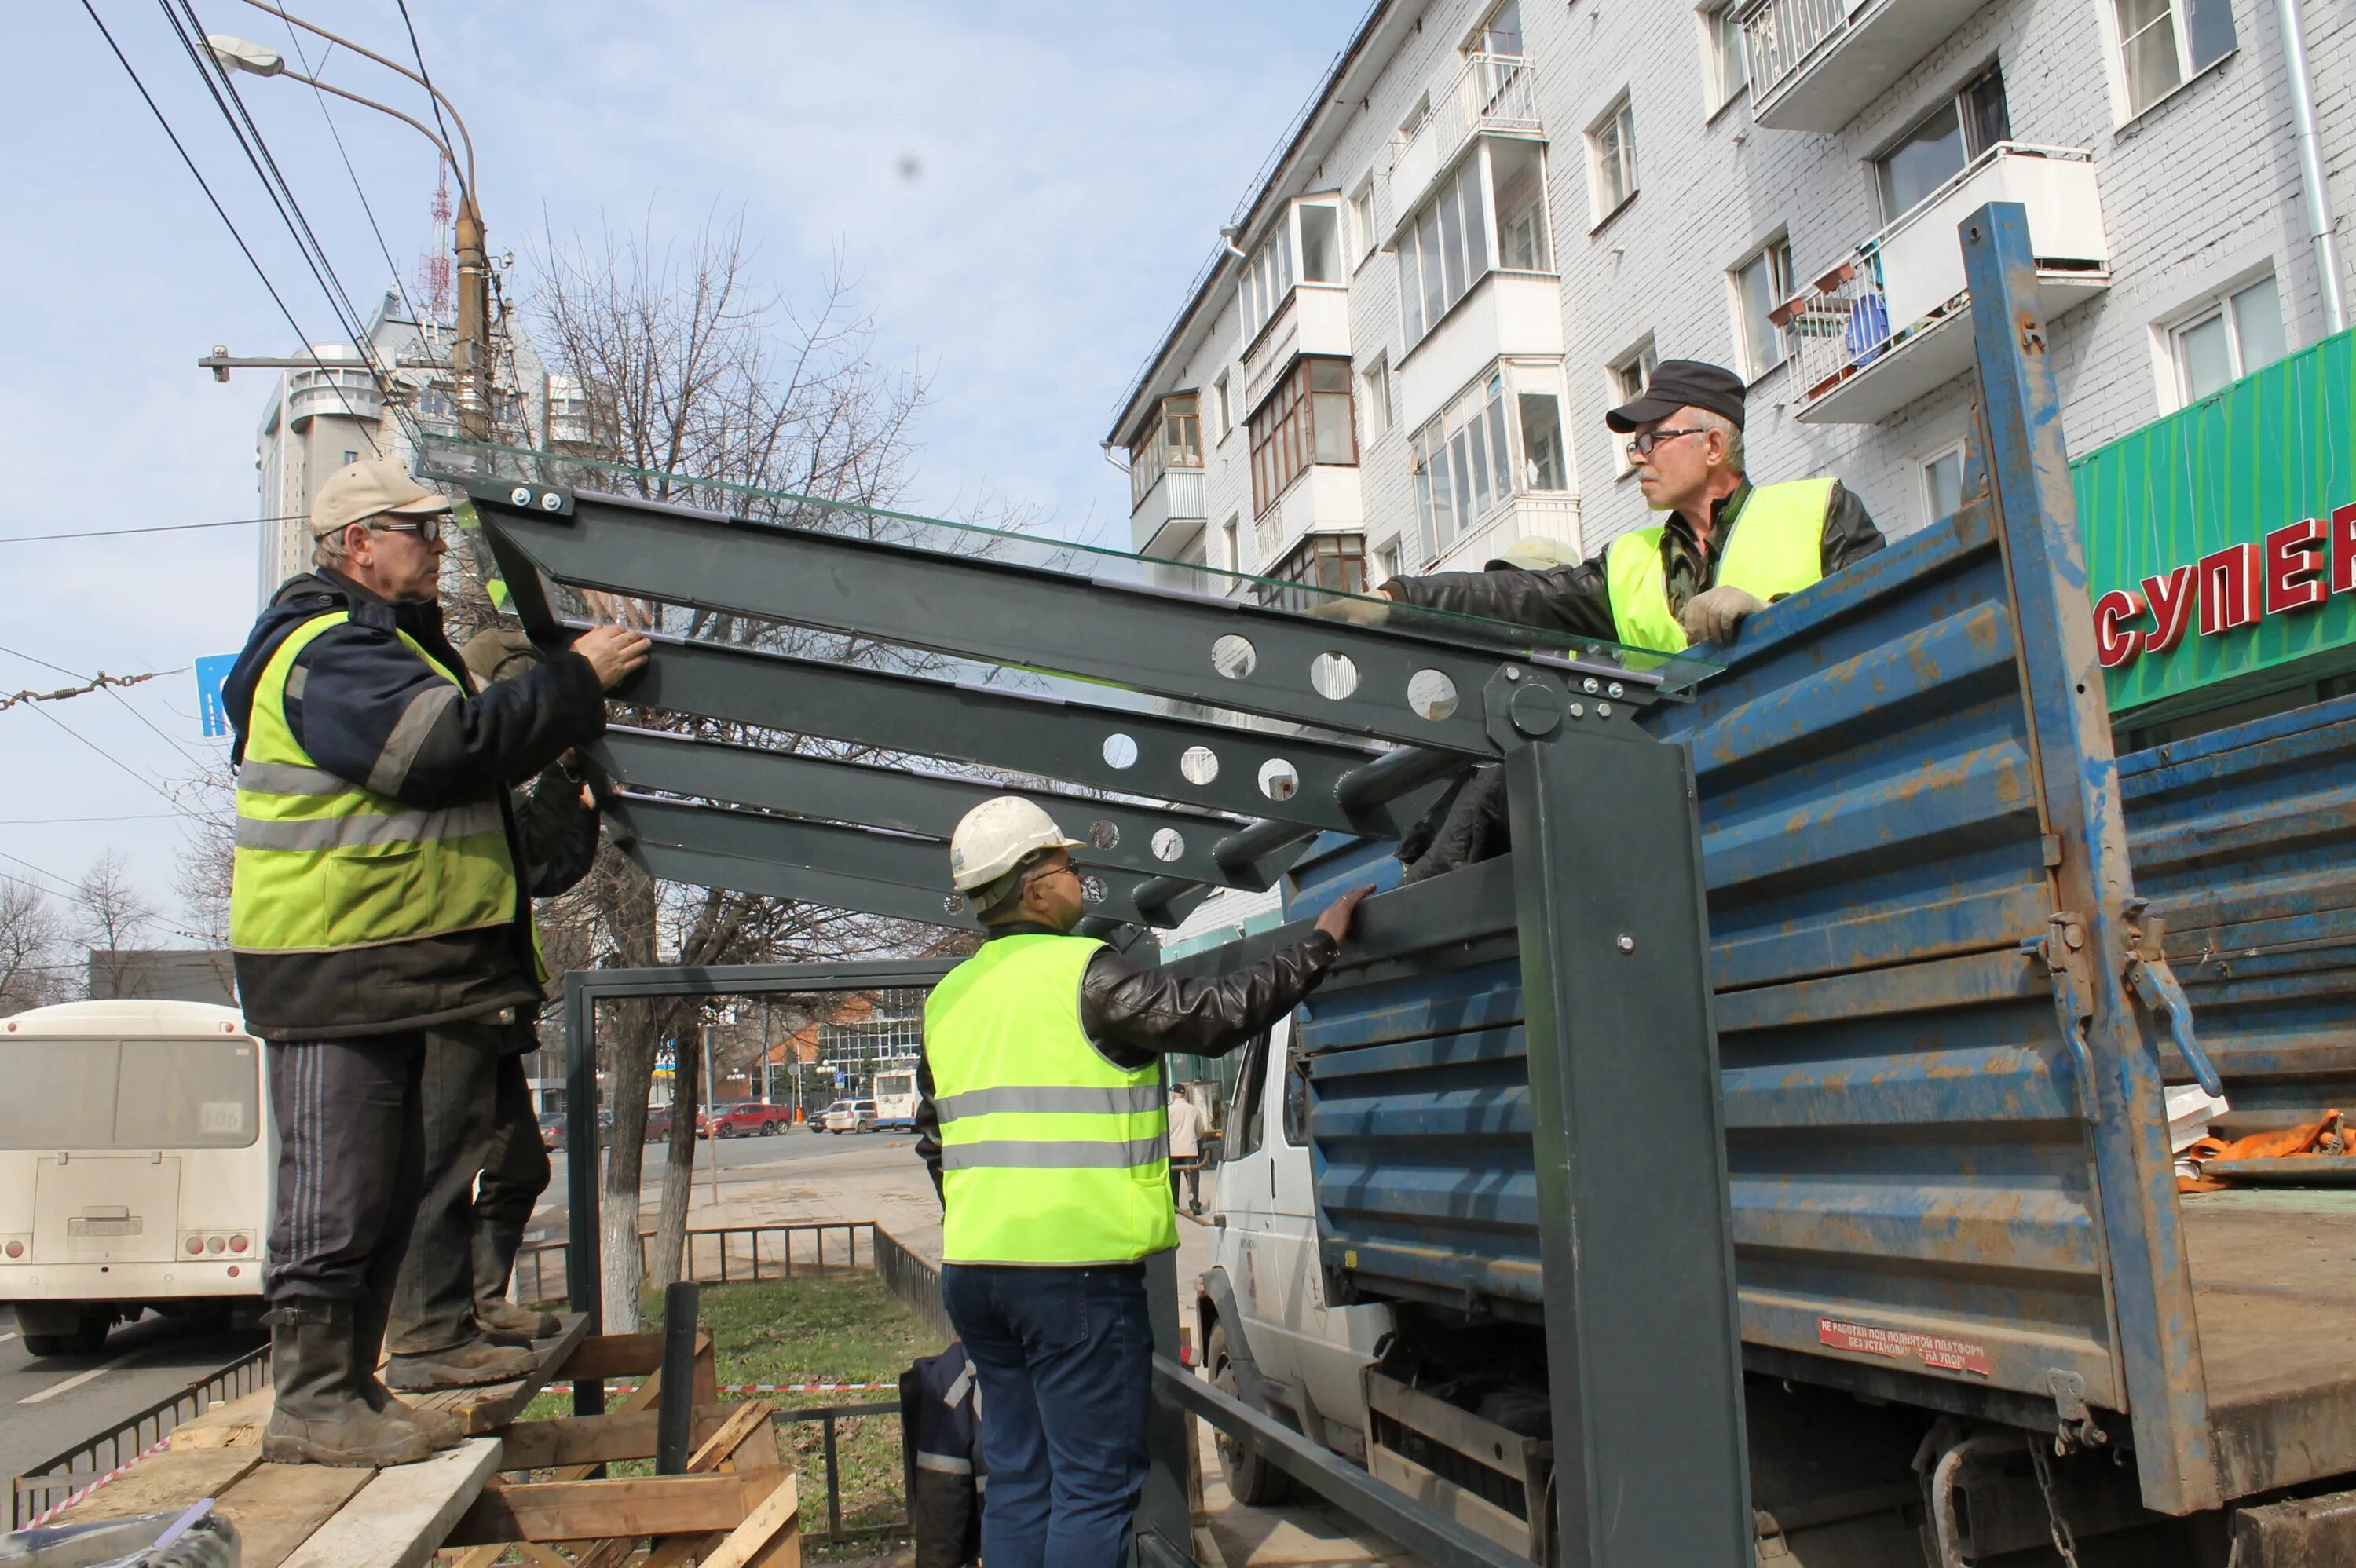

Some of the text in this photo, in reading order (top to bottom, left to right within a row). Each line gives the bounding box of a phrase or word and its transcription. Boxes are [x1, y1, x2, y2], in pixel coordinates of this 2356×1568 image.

[1821, 1320, 1832, 1331] НЕ
[1868, 1328, 1886, 1343] ПОД
[1887, 1331, 1933, 1349] ПОДНЯТОЙ
[1848, 1336, 1863, 1349] БЕЗ
[1925, 1350, 1938, 1361] НА
